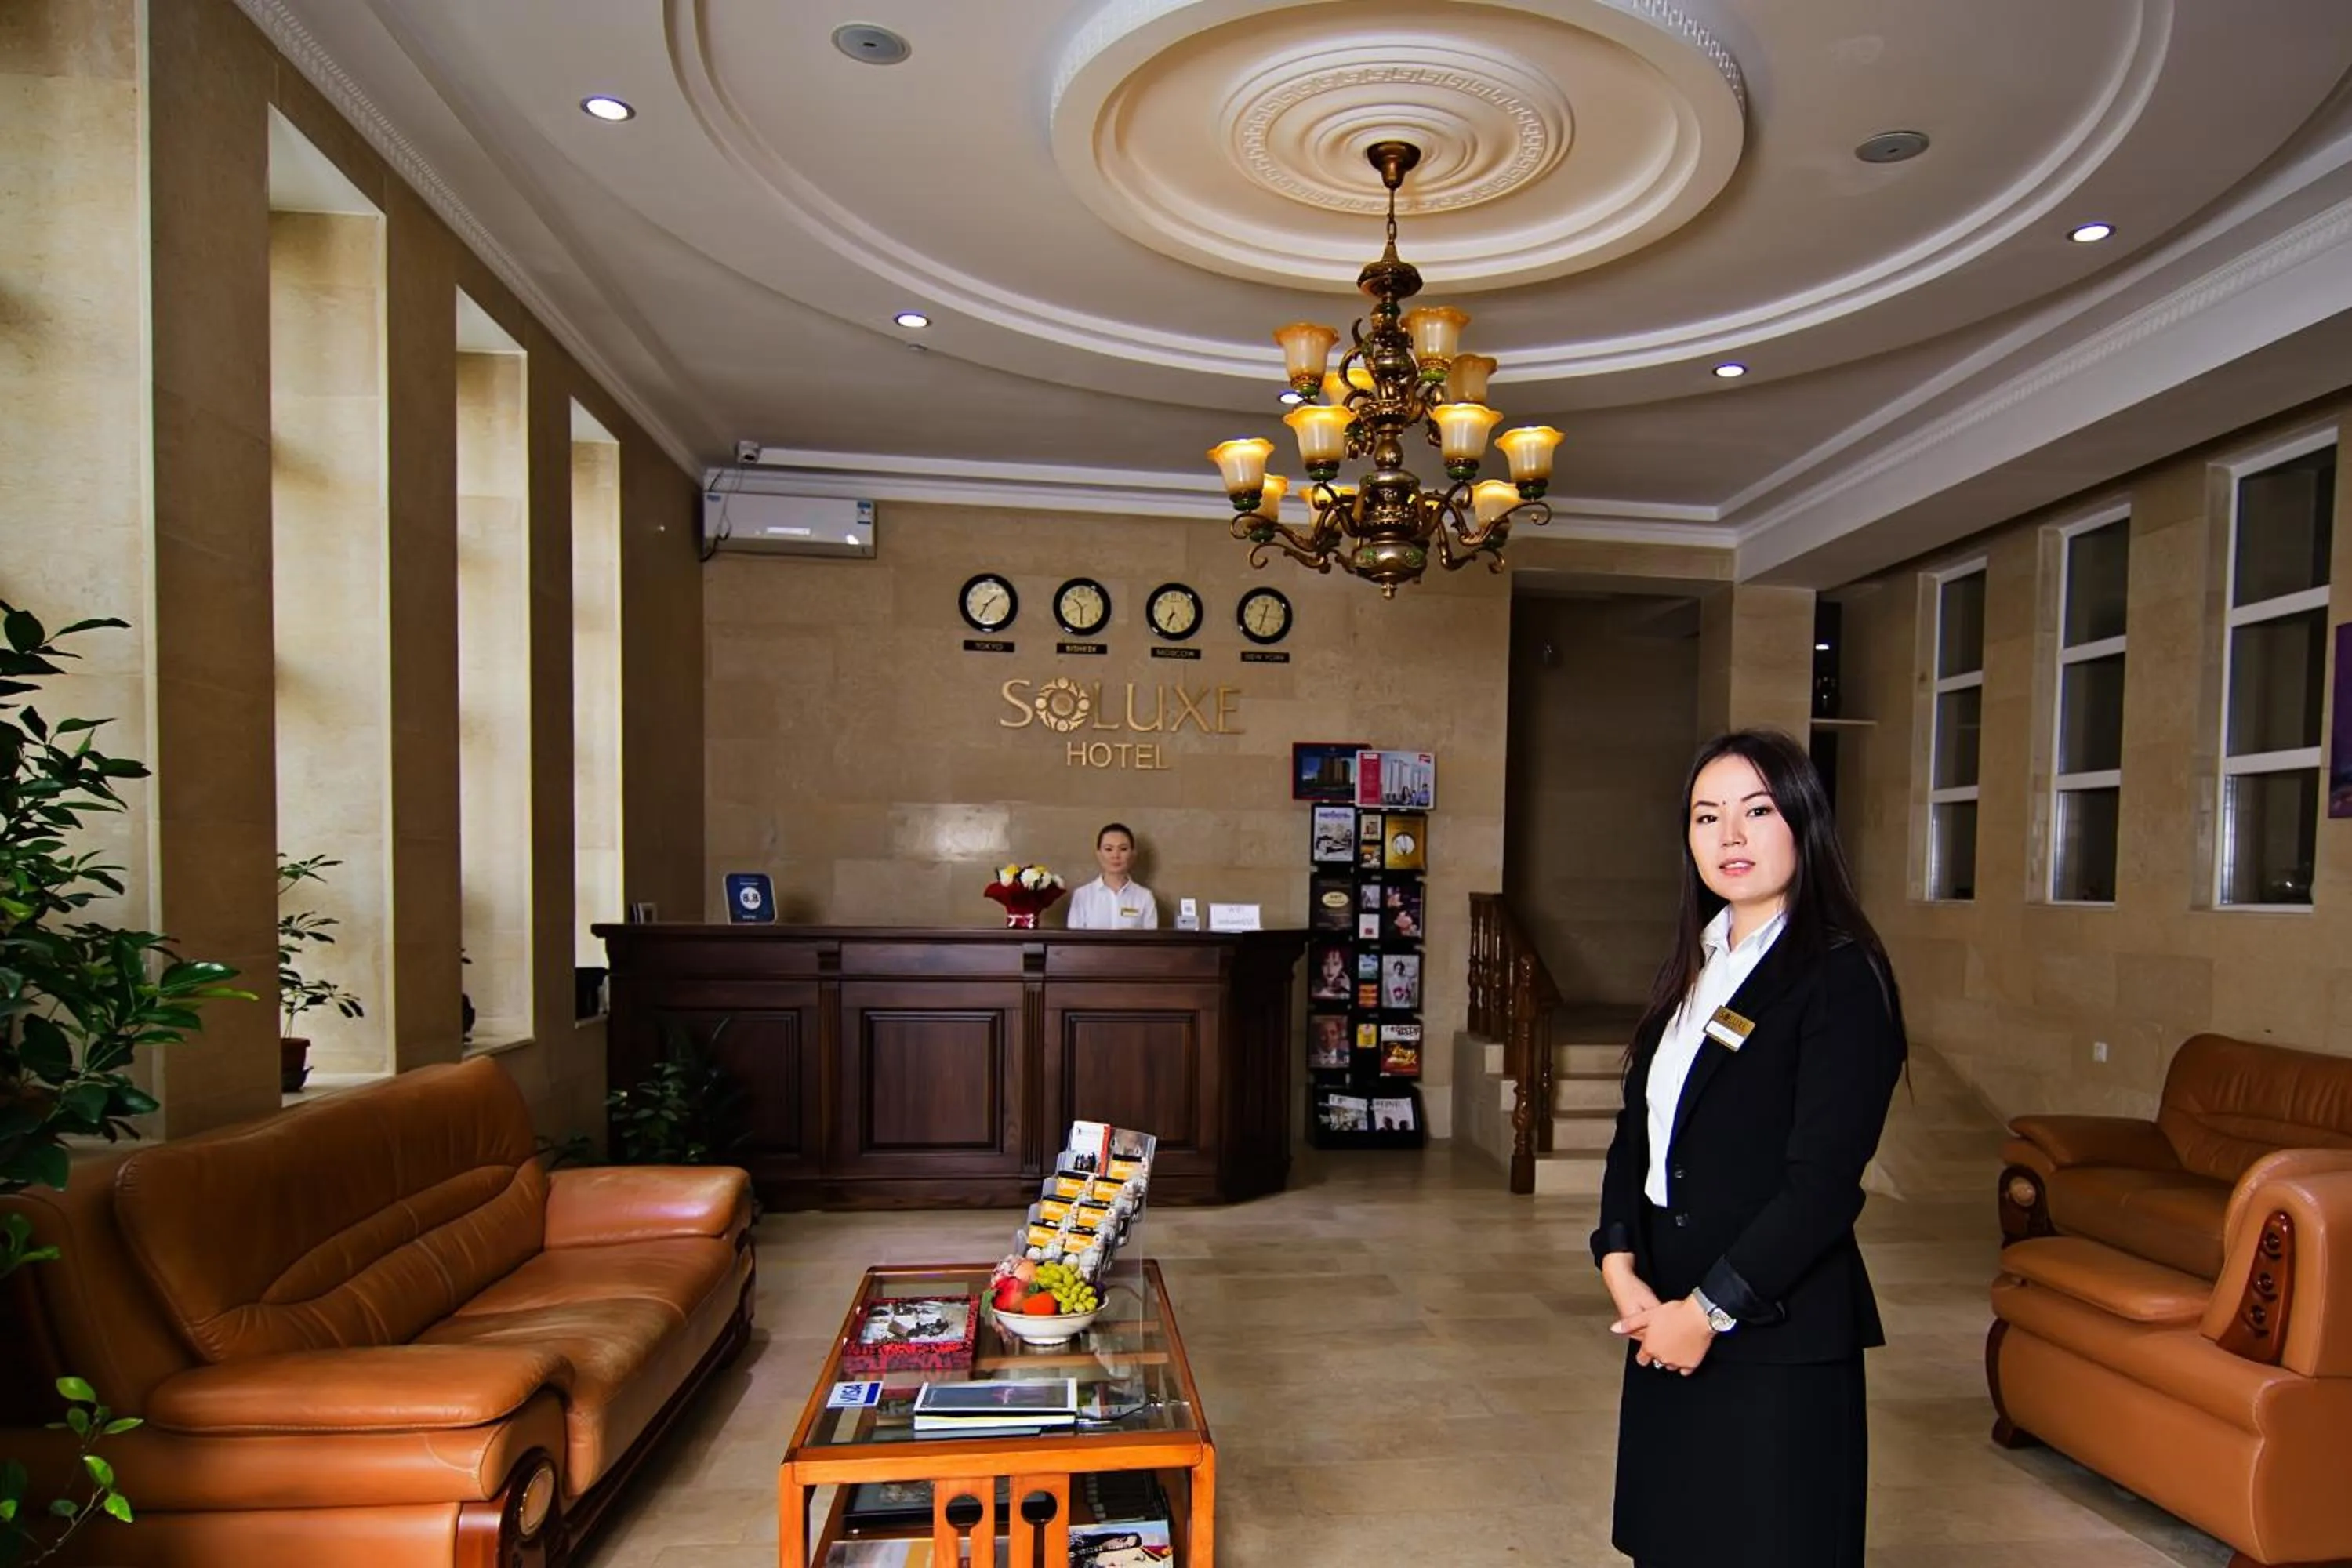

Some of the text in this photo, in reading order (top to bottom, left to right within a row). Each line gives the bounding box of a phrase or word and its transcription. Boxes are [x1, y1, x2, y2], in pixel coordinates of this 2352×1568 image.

[1156, 648, 1195, 658] MOSCOW
[999, 677, 1245, 735] SOLUXE
[1066, 741, 1170, 770] HOTEL
[840, 1384, 863, 1403] VISA
